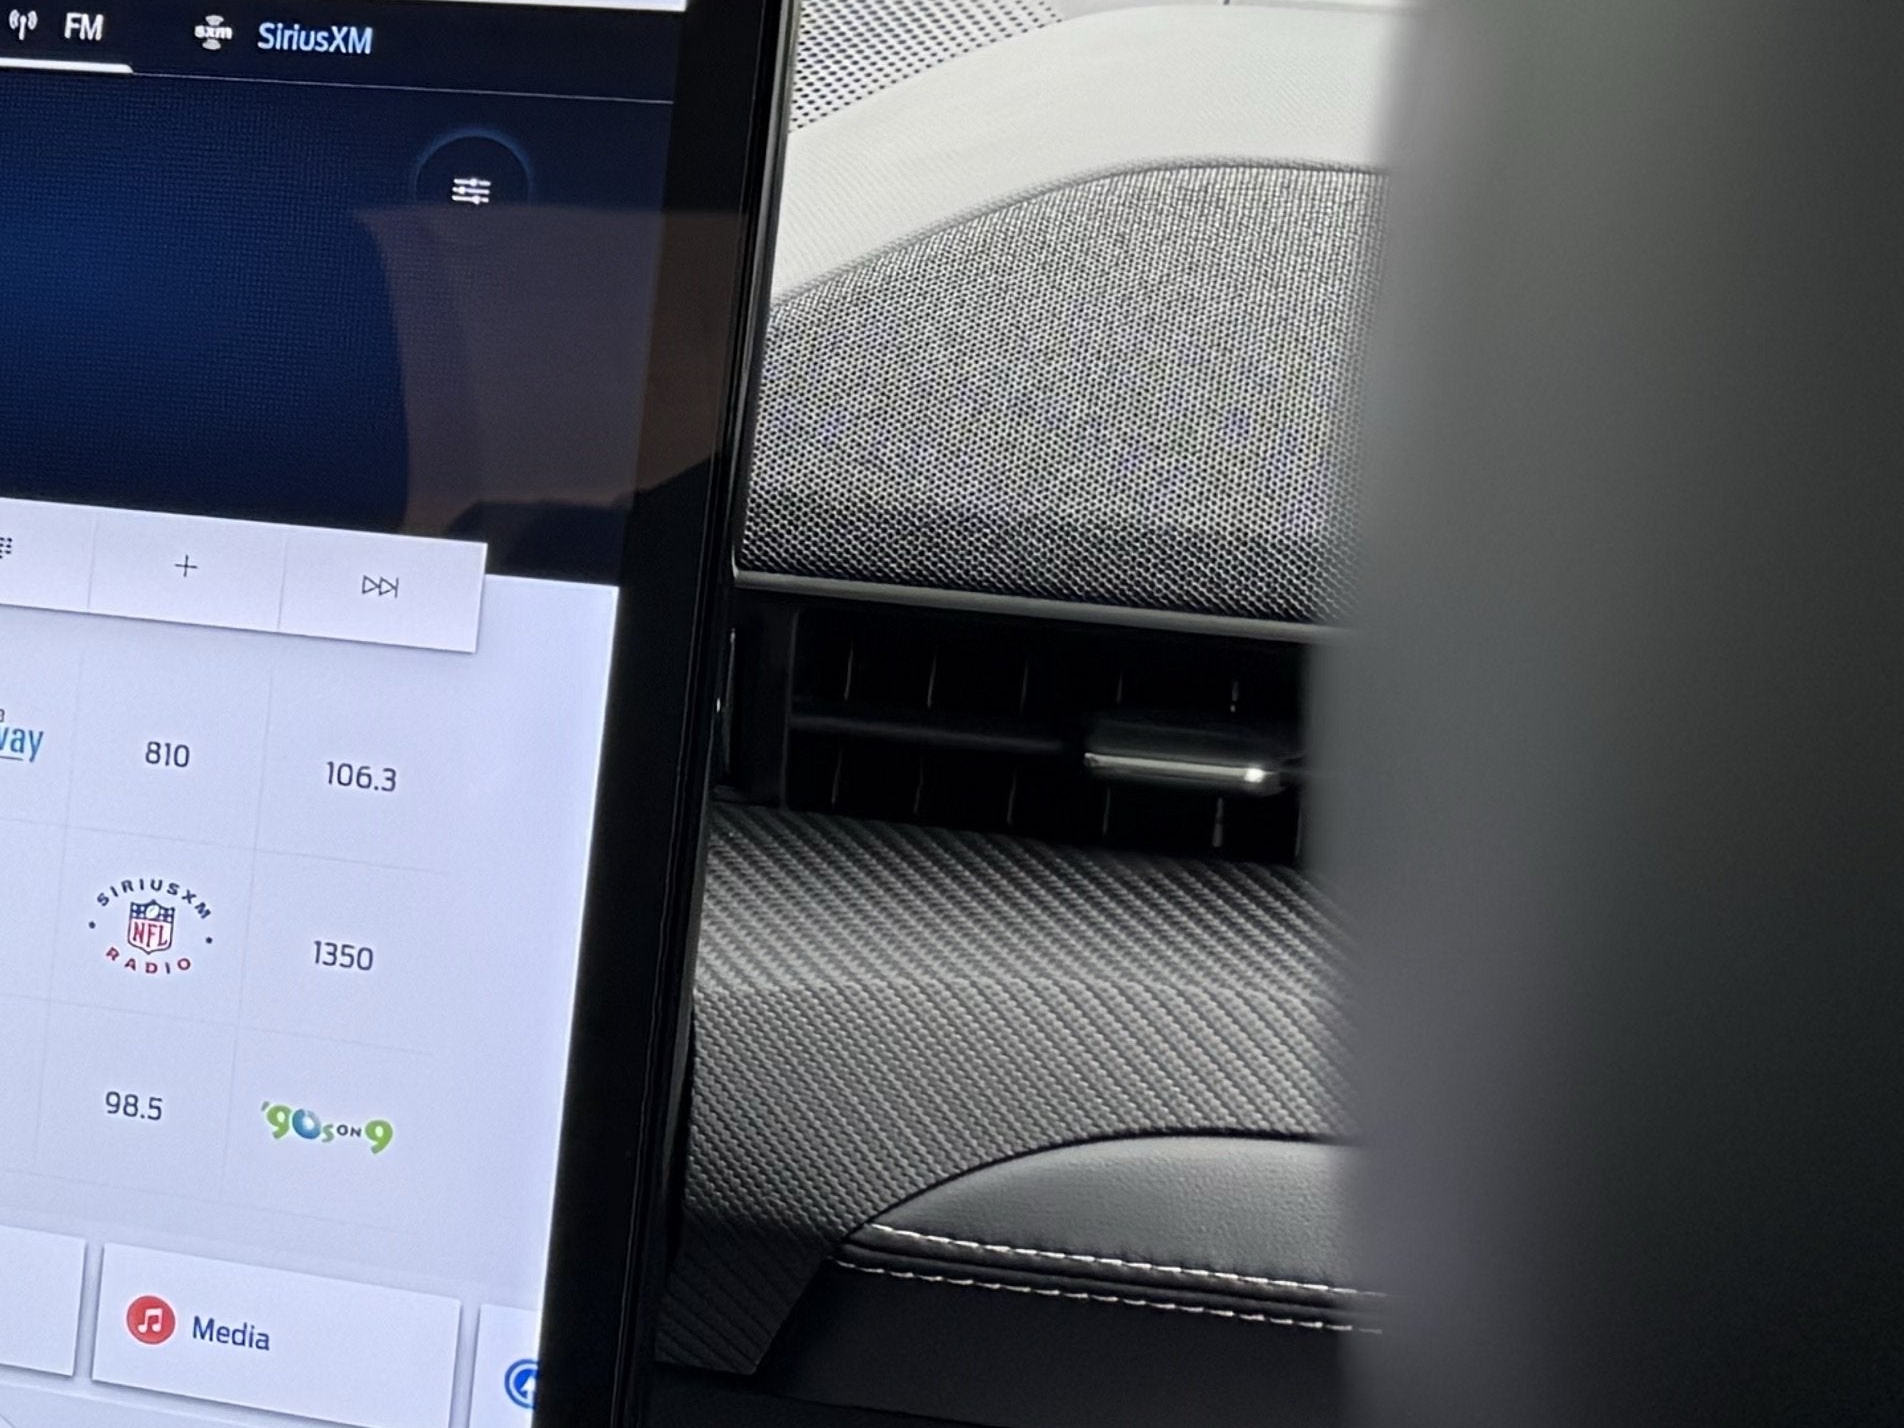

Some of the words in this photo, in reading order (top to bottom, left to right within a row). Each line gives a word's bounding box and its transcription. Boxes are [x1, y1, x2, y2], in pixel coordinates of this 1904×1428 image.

[63, 11, 104, 42] FM
[257, 22, 374, 56] SiriusXM
[144, 740, 191, 770] 810
[325, 760, 398, 794] 106.3
[96, 878, 212, 919] SIRIUSXM
[132, 920, 168, 948] NFL
[105, 946, 192, 974] RADIO
[312, 939, 375, 972] 1350
[104, 1089, 164, 1123] 98.5
[364, 1119, 395, 1156] 9
[192, 1315, 271, 1352] Media
